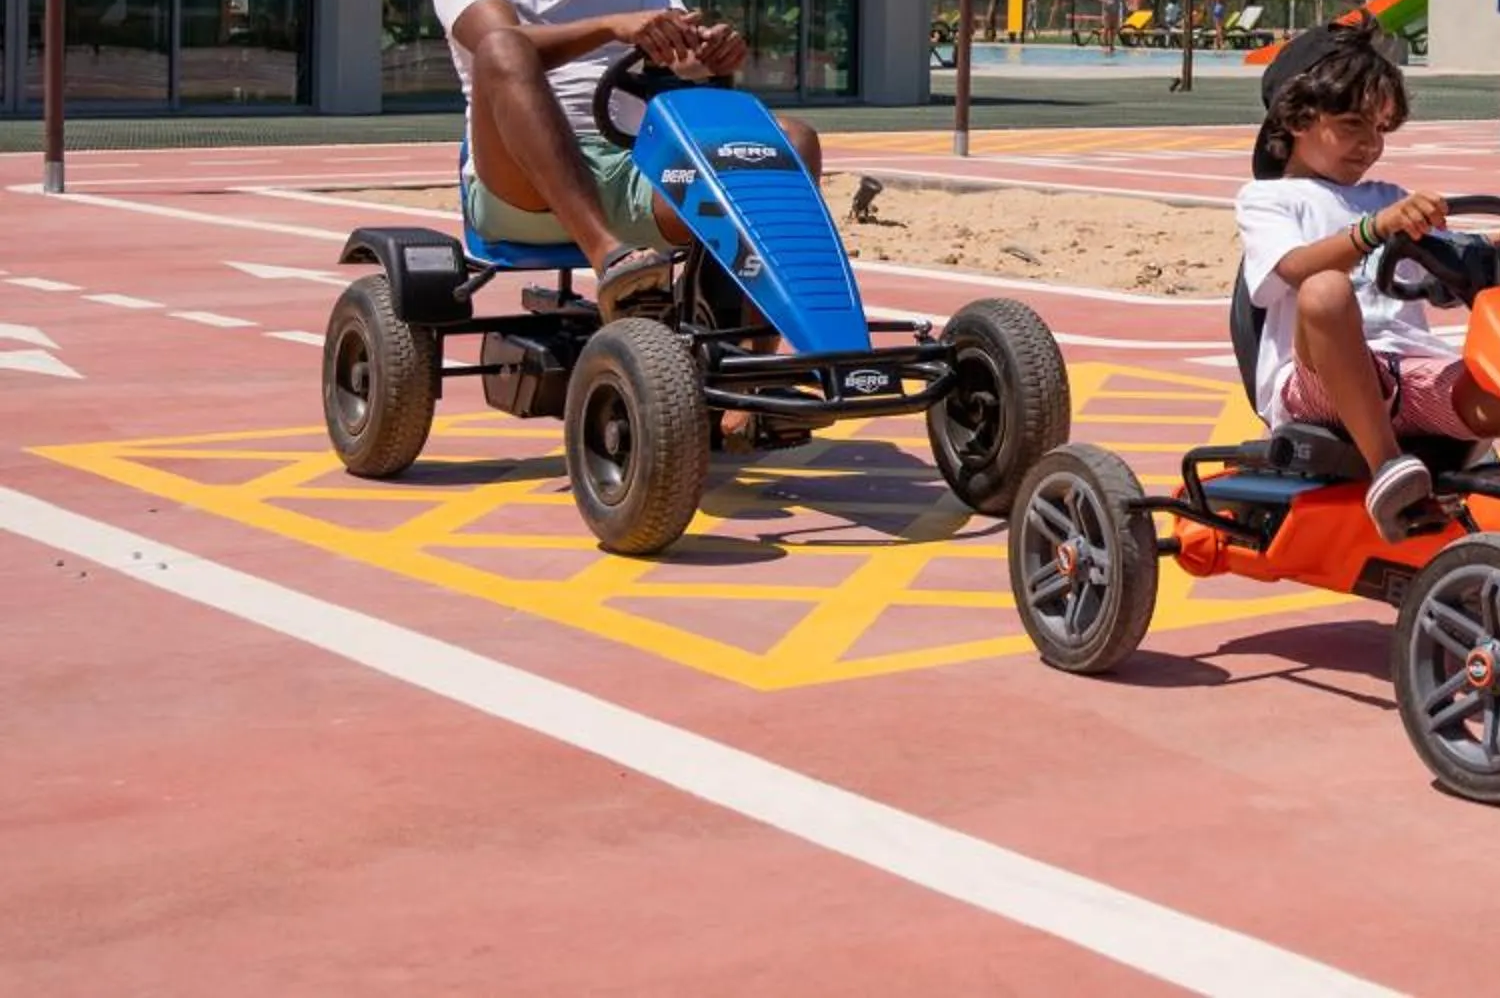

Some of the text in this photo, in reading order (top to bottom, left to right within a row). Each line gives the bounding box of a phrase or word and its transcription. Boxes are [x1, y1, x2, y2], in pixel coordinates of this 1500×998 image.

[717, 145, 777, 158] BERG
[661, 169, 697, 183] BERG
[845, 374, 889, 387] BERG
